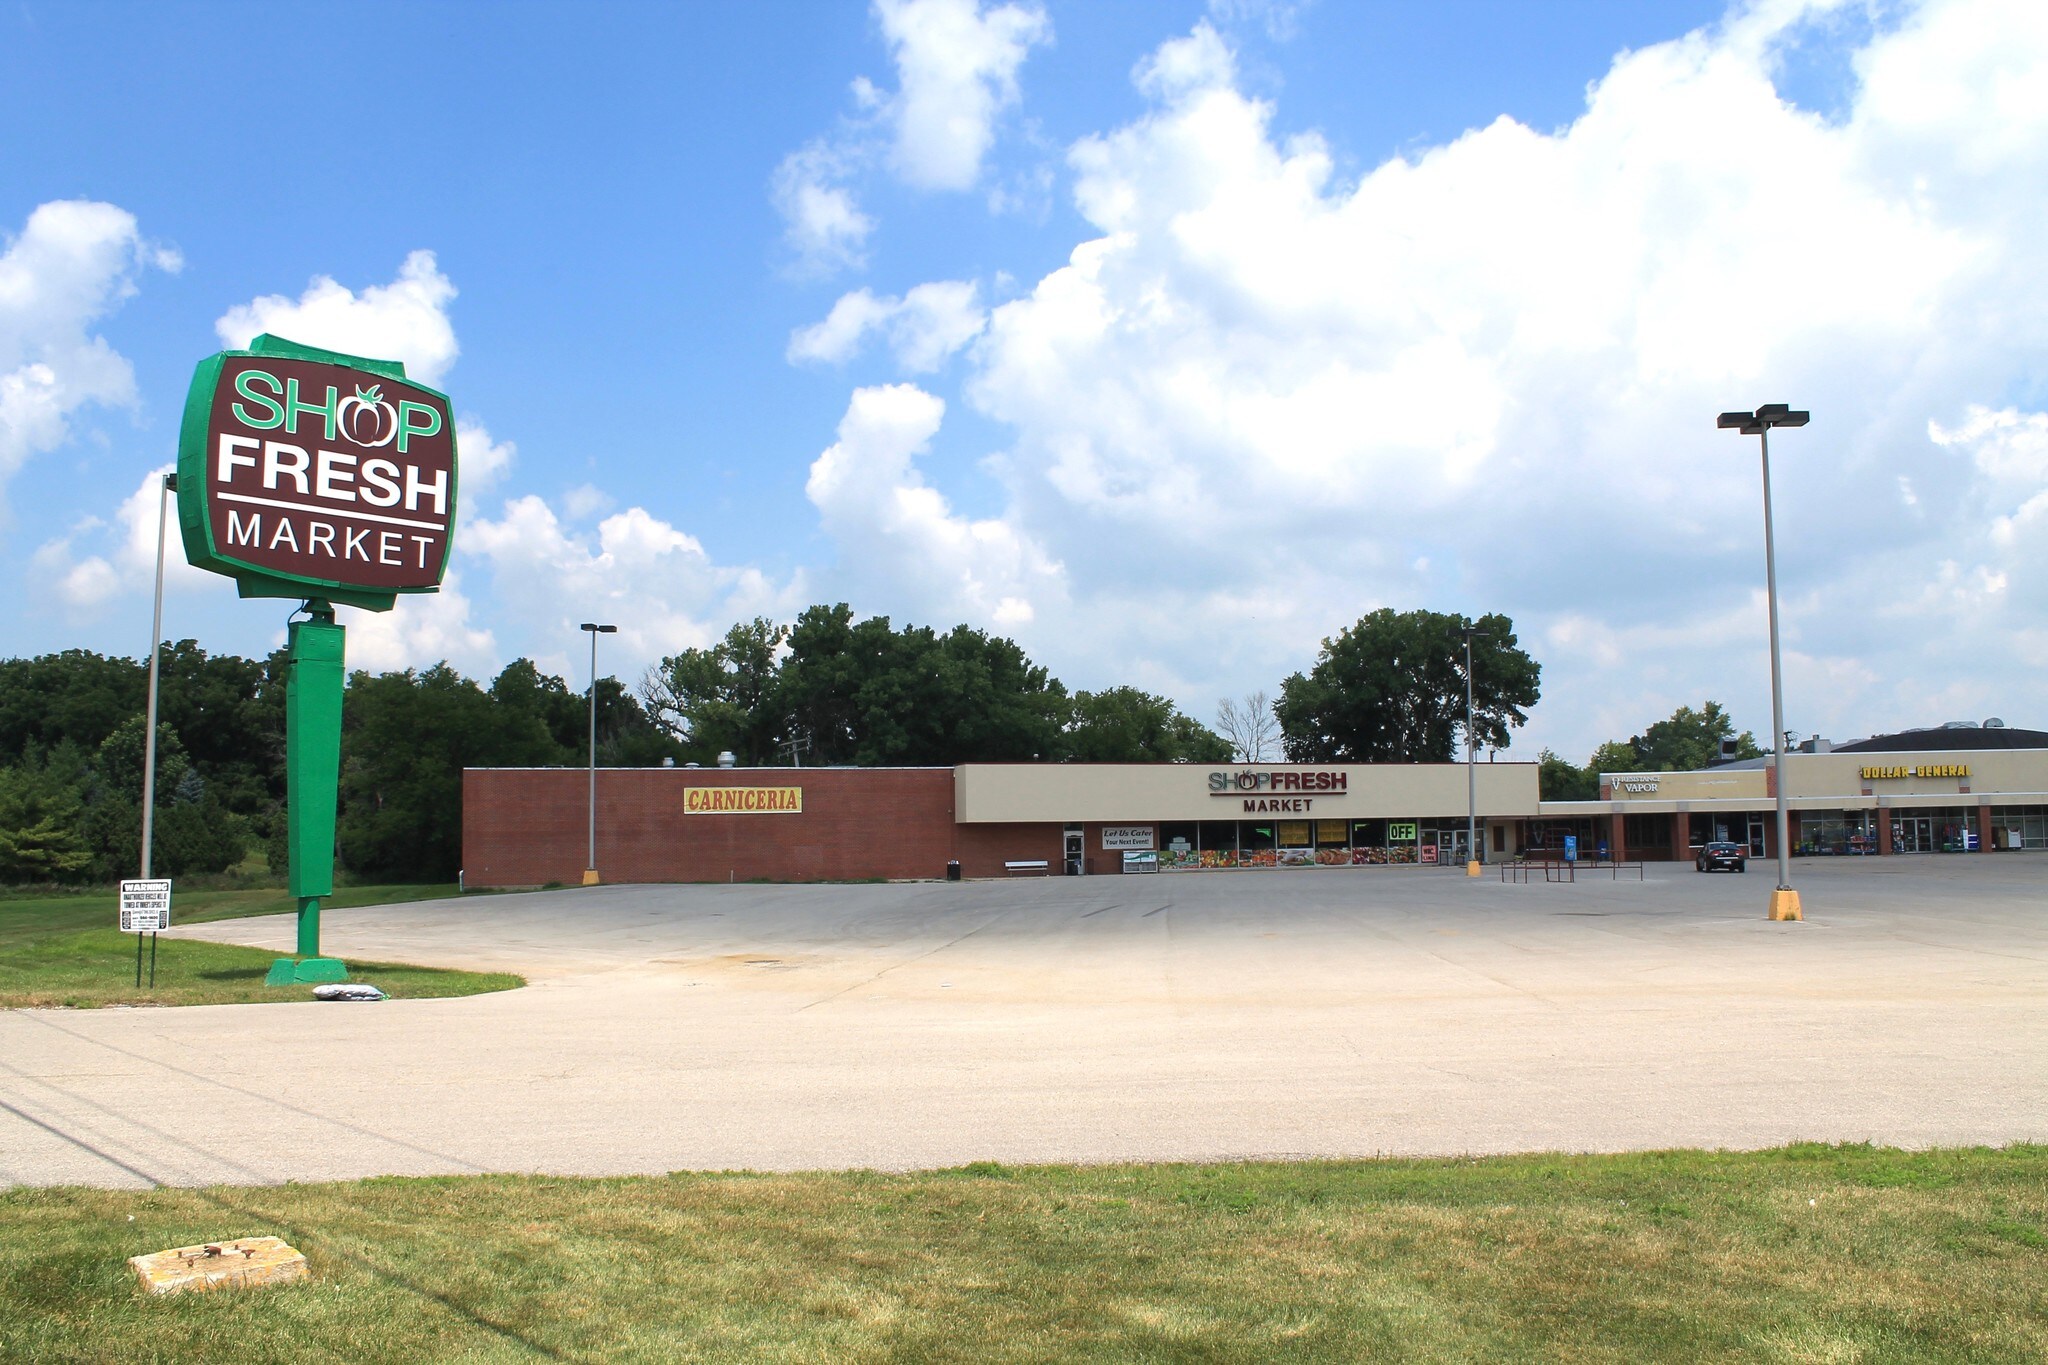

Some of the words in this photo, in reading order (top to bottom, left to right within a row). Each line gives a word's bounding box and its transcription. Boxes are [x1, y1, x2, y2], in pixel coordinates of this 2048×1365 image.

[232, 369, 442, 453] SHOP
[217, 433, 448, 515] FRESH
[227, 510, 434, 569] MARKET
[1862, 767, 1909, 779] DOLLAR
[1916, 765, 1972, 777] GENERAL
[1625, 784, 1658, 792] VAPOR
[688, 790, 797, 810] CARNICERIA
[1244, 800, 1312, 812] MARKET
[1119, 829, 1129, 837] Us
[1131, 829, 1152, 837] Cater
[1391, 826, 1412, 838] OFF
[124, 883, 167, 891] WARNING
